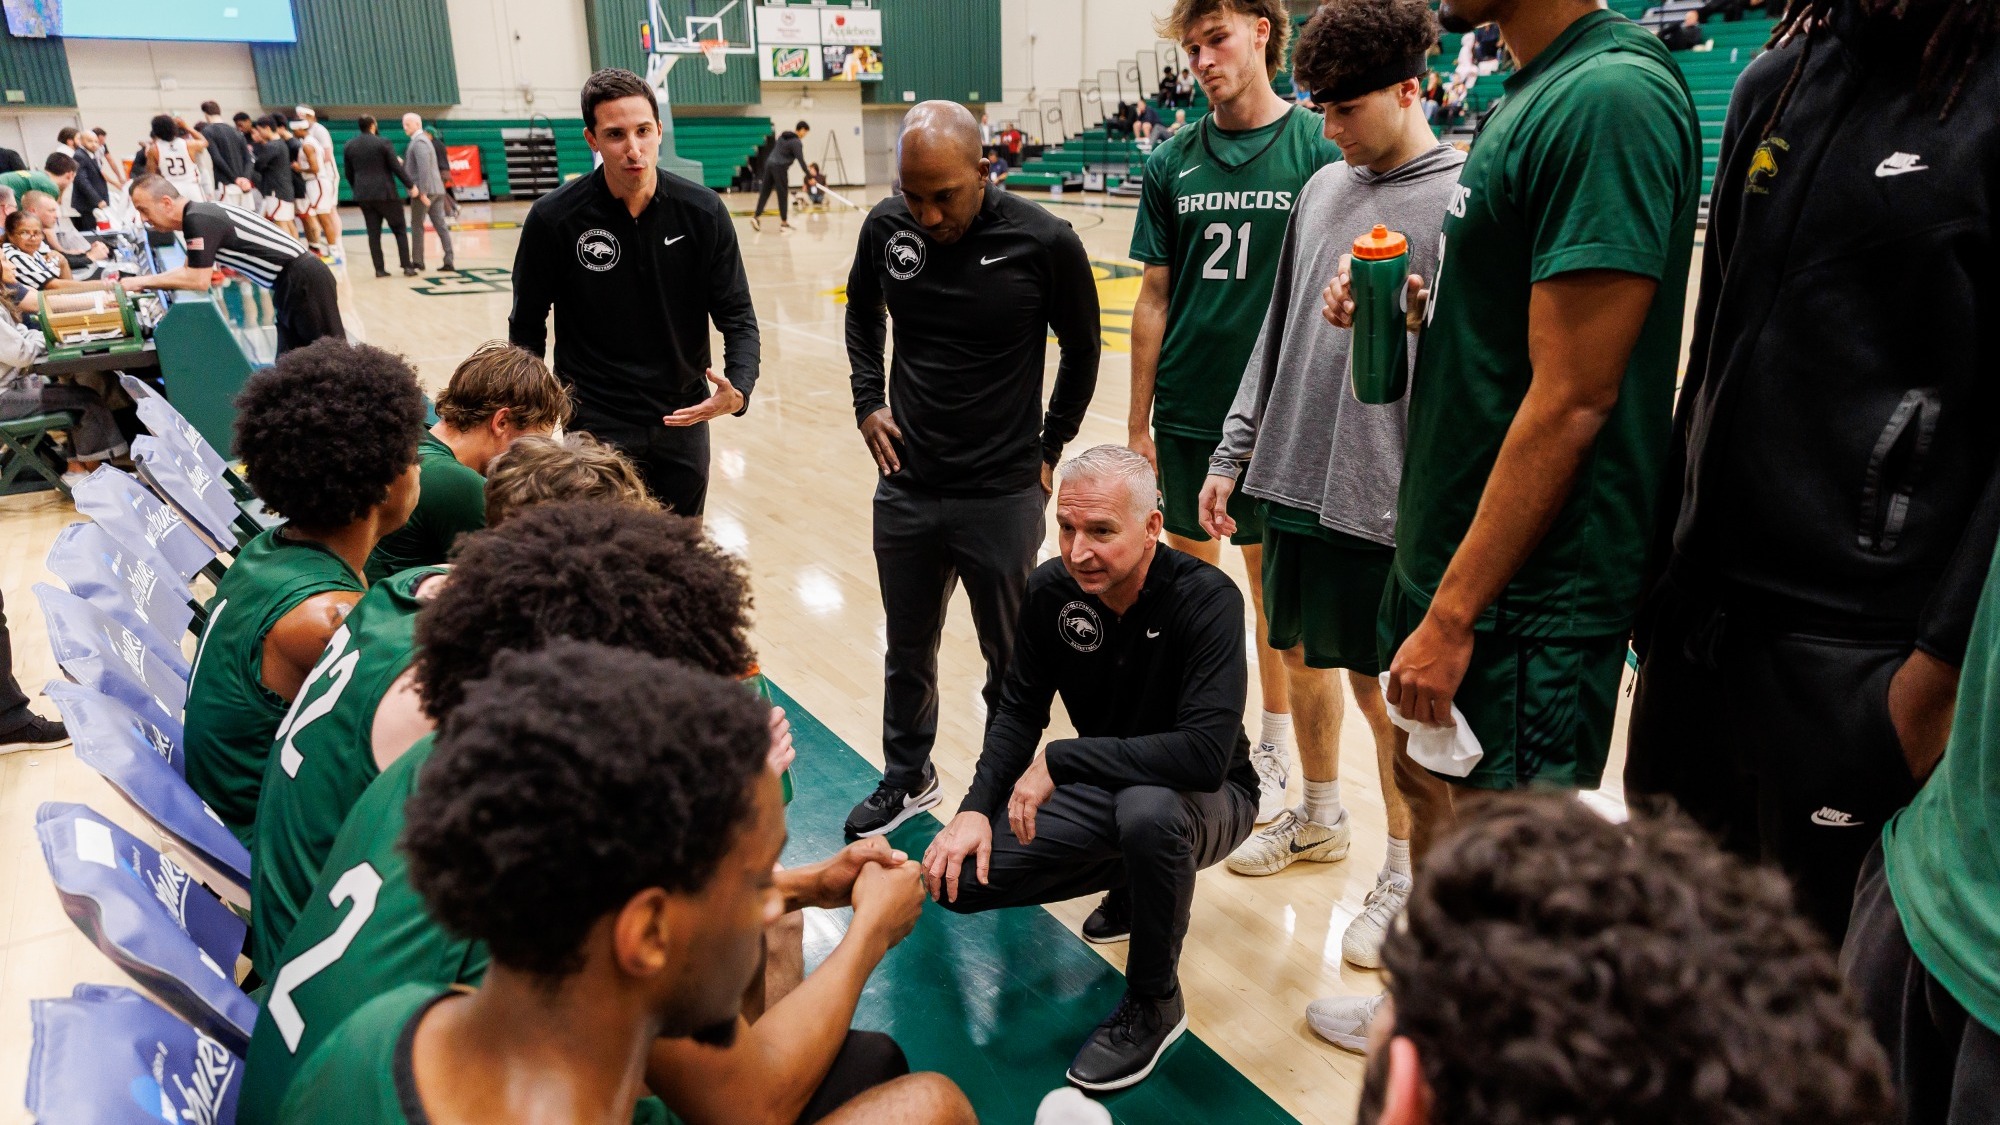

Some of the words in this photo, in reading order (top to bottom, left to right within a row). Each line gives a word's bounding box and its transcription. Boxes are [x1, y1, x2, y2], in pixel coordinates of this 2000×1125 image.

[165, 157, 187, 176] 23
[1178, 190, 1292, 214] BRONCOS
[1202, 221, 1252, 280] 21
[1818, 805, 1853, 823] NIKE
[267, 861, 384, 1054] 2
